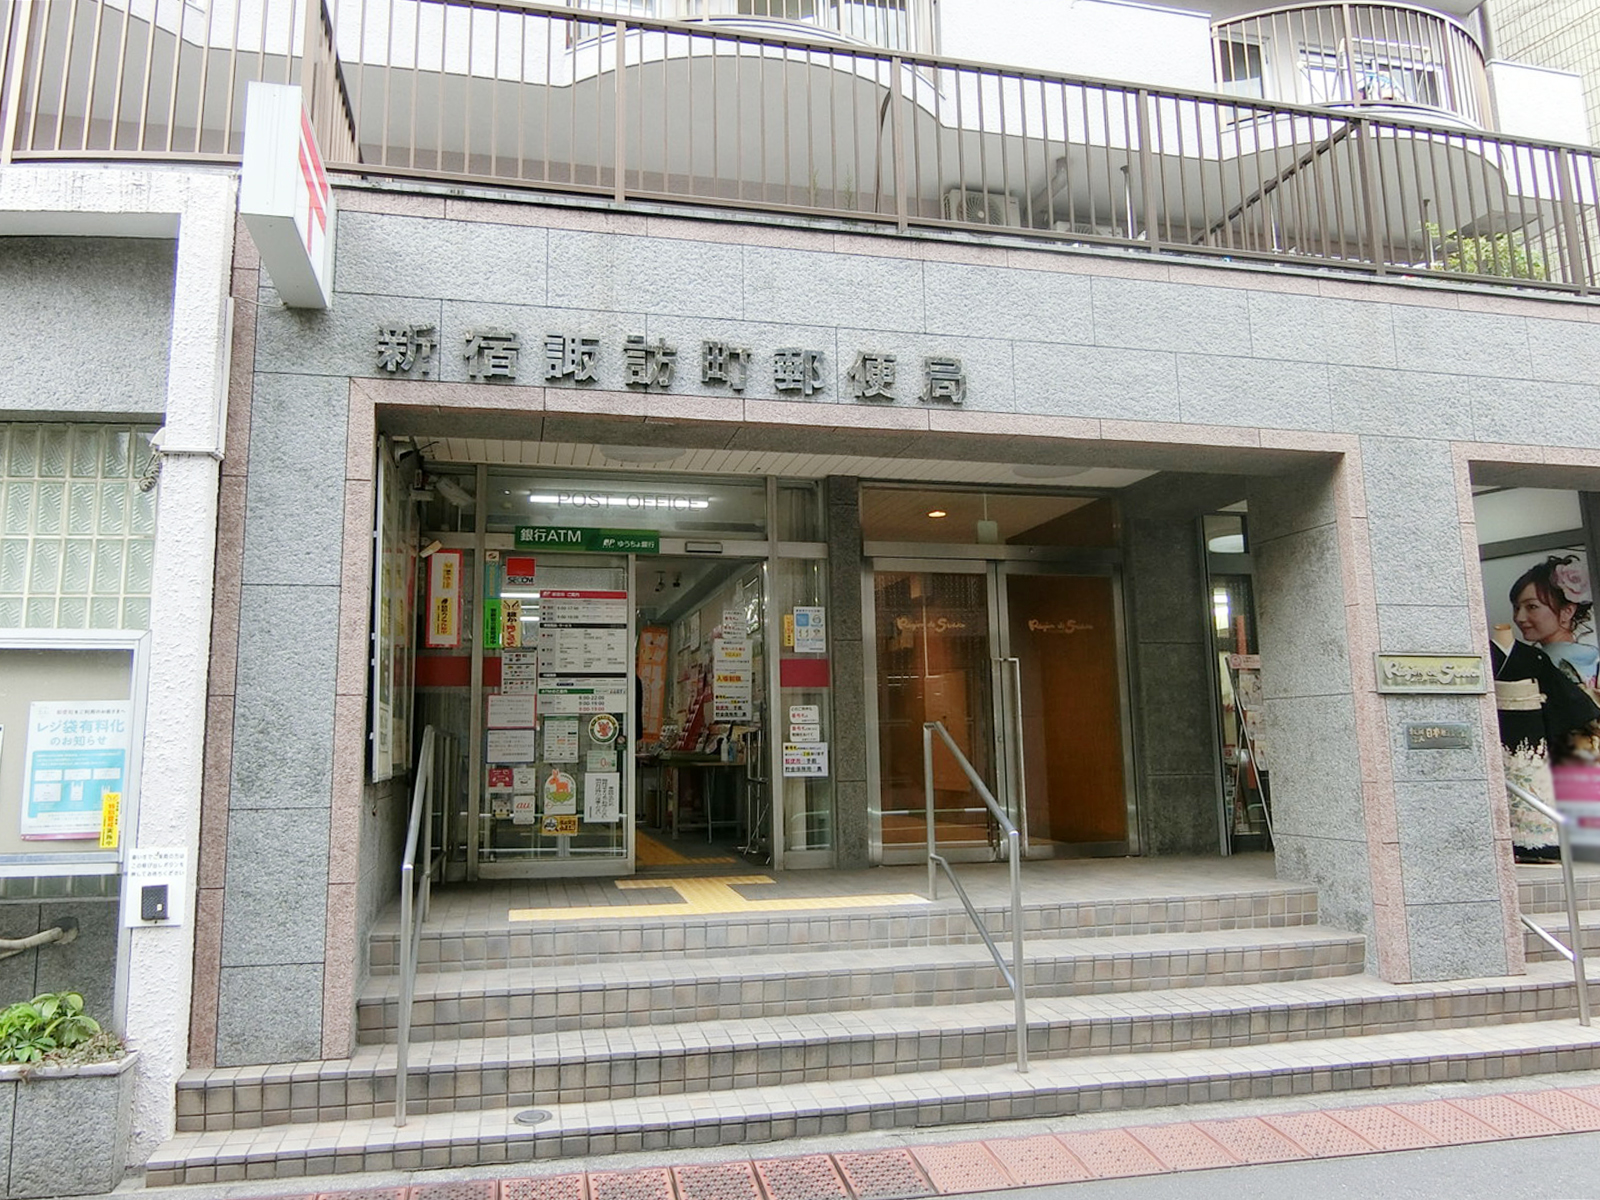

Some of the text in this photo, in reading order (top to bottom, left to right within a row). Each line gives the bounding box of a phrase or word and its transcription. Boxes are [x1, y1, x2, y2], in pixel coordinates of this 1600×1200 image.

[376, 323, 967, 404] 新宿諏訪町郵便局
[558, 491, 700, 511] POST OFFICE
[520, 528, 582, 543] 銀行ATM
[617, 541, 655, 549] ゆうちょ銀行
[507, 576, 535, 585] SECOM
[37, 719, 125, 734] レジ袋有料化
[50, 735, 107, 747] のお知らせ
